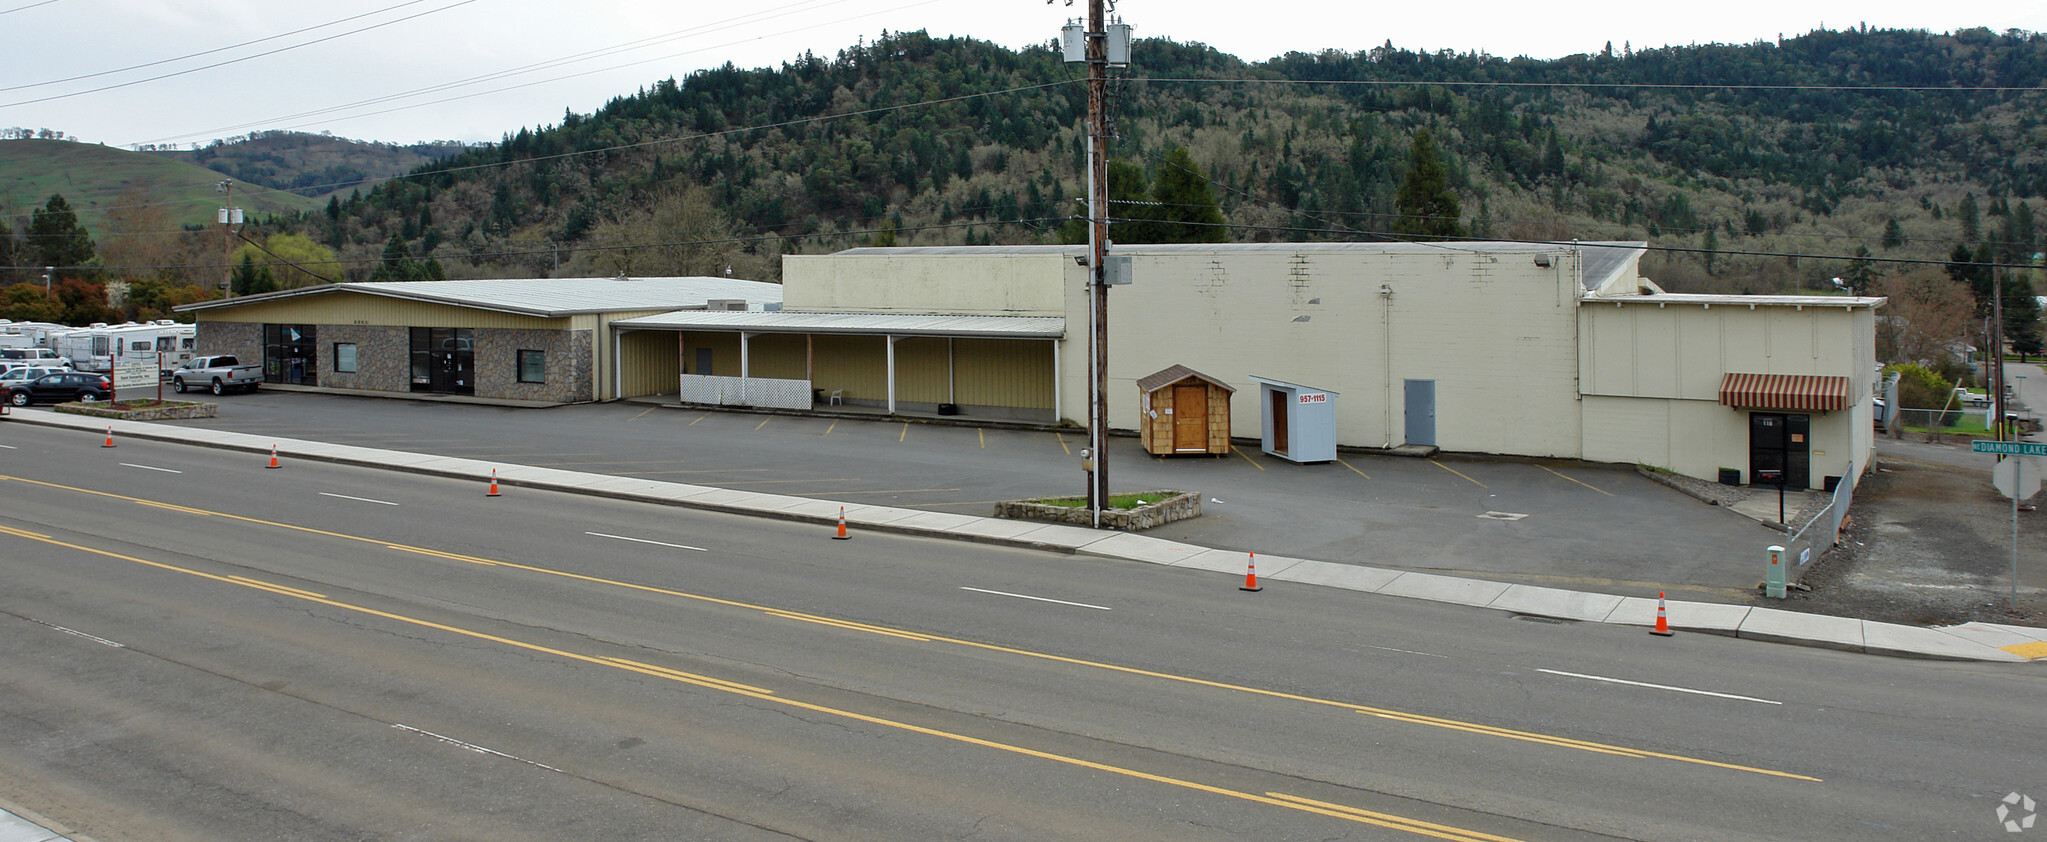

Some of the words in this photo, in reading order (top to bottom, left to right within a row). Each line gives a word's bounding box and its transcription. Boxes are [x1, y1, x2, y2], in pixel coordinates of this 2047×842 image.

[1300, 394, 1325, 403] 957-1115
[1981, 442, 2020, 453] DIAMOND
[2024, 445, 2047, 455] LAKE
